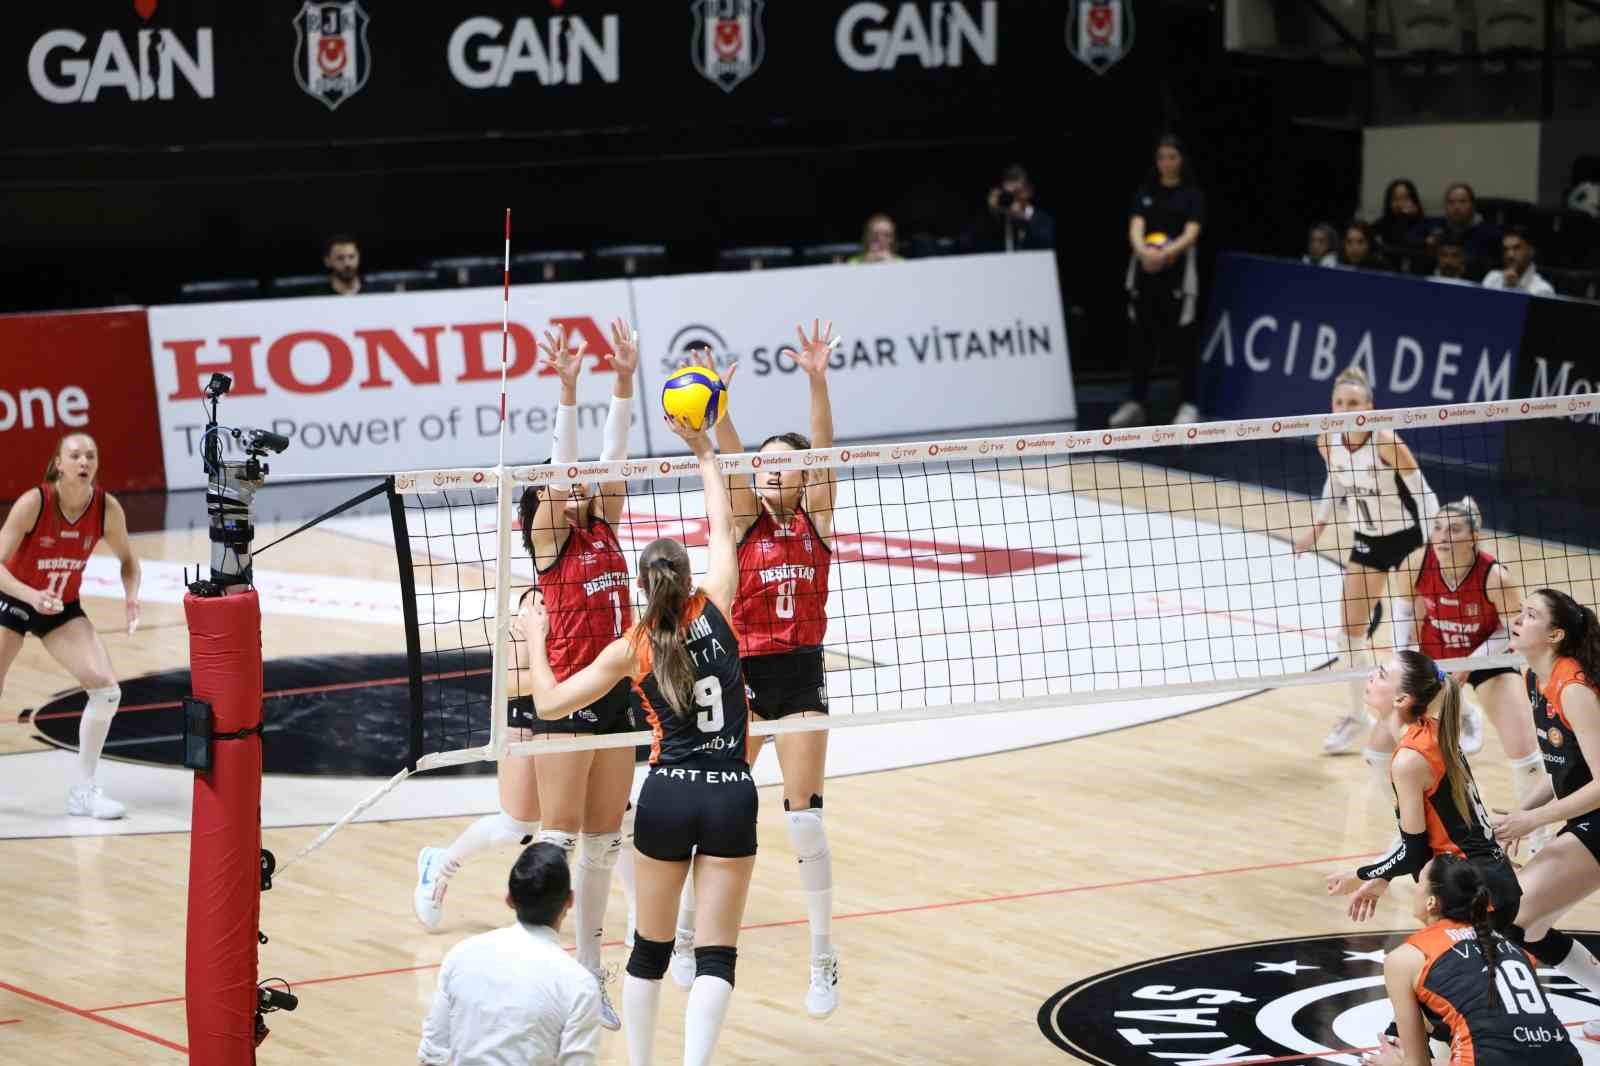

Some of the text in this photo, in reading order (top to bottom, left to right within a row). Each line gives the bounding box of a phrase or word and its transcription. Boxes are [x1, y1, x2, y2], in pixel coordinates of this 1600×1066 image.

[28, 28, 214, 104] GAIN
[447, 15, 620, 89] GAIN
[835, 1, 997, 72] GAIN
[162, 315, 614, 401] HONDA
[752, 337, 898, 377] SOGAR
[908, 316, 1052, 364] VİTAMİN
[271, 413, 408, 451] Power
[420, 405, 462, 443] of
[477, 402, 637, 436] Drem
[672, 462, 701, 471] vodafon
[724, 460, 740, 469] TVF
[762, 457, 792, 465] vodafone
[815, 455, 829, 463] TVF
[851, 450, 880, 459] vodafone
[939, 445, 968, 454] vodafone
[1026, 439, 1056, 448] vodafone
[1113, 433, 1141, 443] vodafone
[1366, 415, 1393, 423] vodafone
[693, 675, 725, 733] 9
[1481, 959, 1547, 1015] 19
[1513, 1026, 1551, 1042] Club
